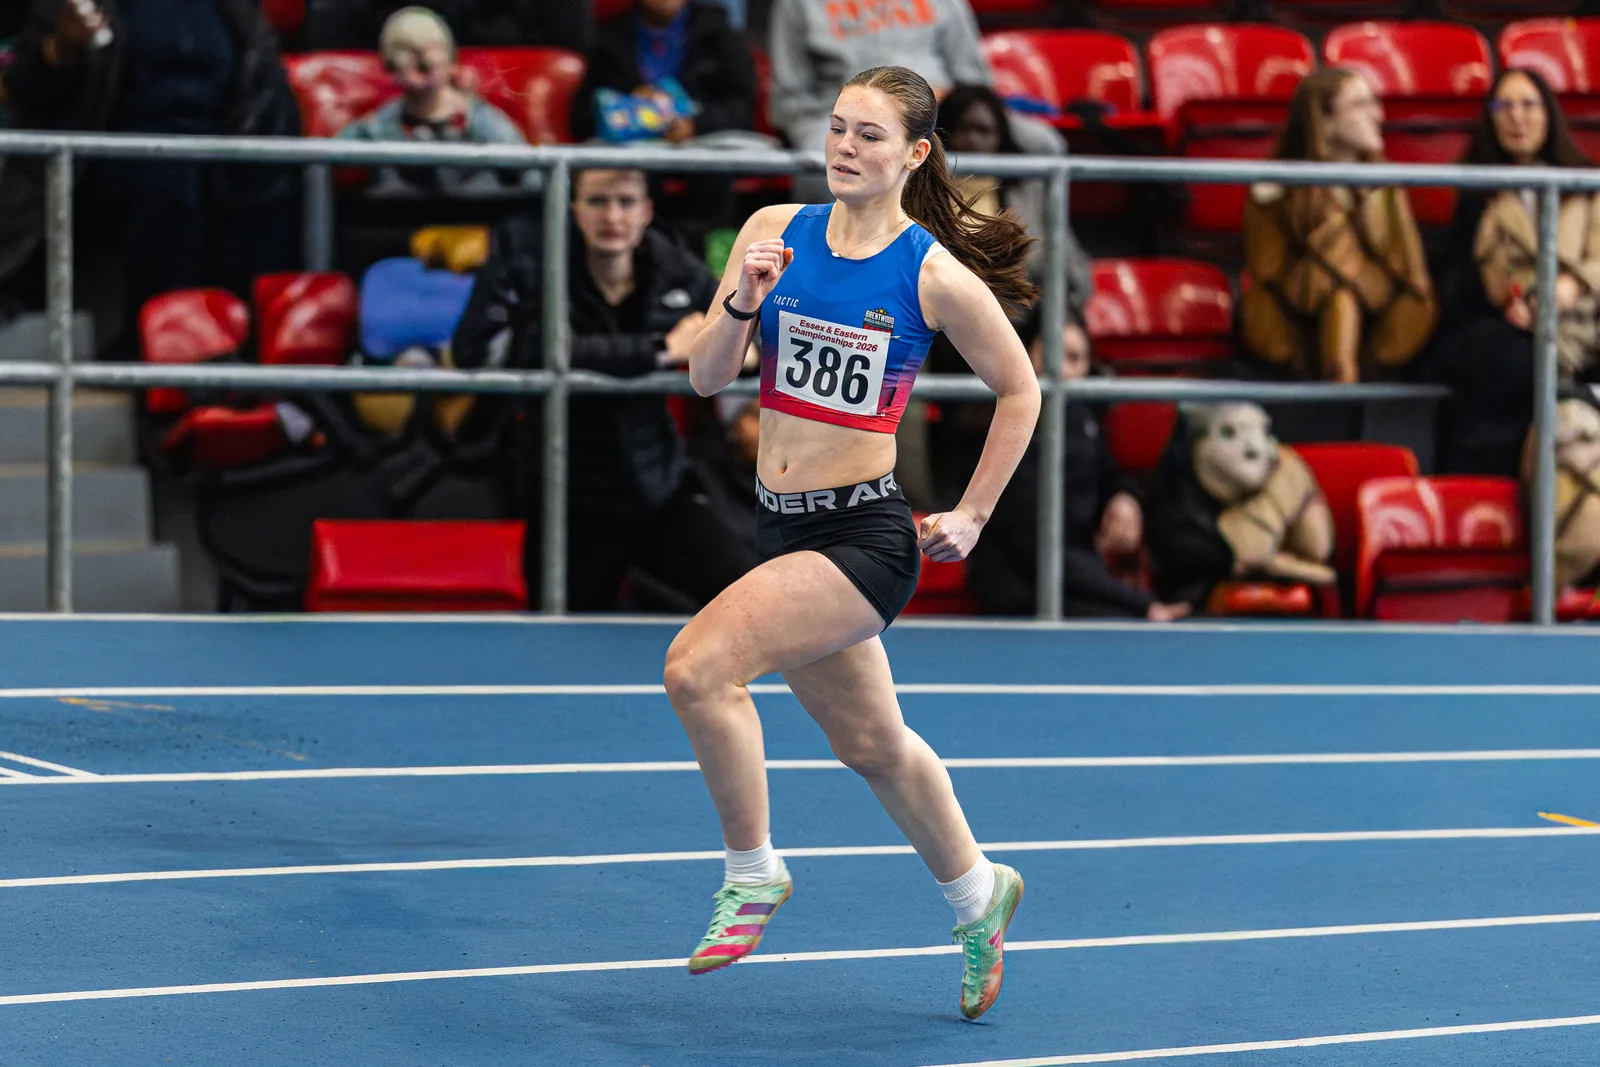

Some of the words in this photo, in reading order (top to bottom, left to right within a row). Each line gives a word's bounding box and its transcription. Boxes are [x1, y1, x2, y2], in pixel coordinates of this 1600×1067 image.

[773, 294, 799, 307] TACTIC
[865, 309, 895, 325] BRENTWOOD
[788, 325, 854, 349] Championships
[855, 341, 878, 352] 2026
[799, 319, 825, 332] Essex
[826, 325, 832, 334] &
[833, 327, 868, 341] Eastern
[785, 337, 871, 405] 386
[847, 471, 898, 508] AR
